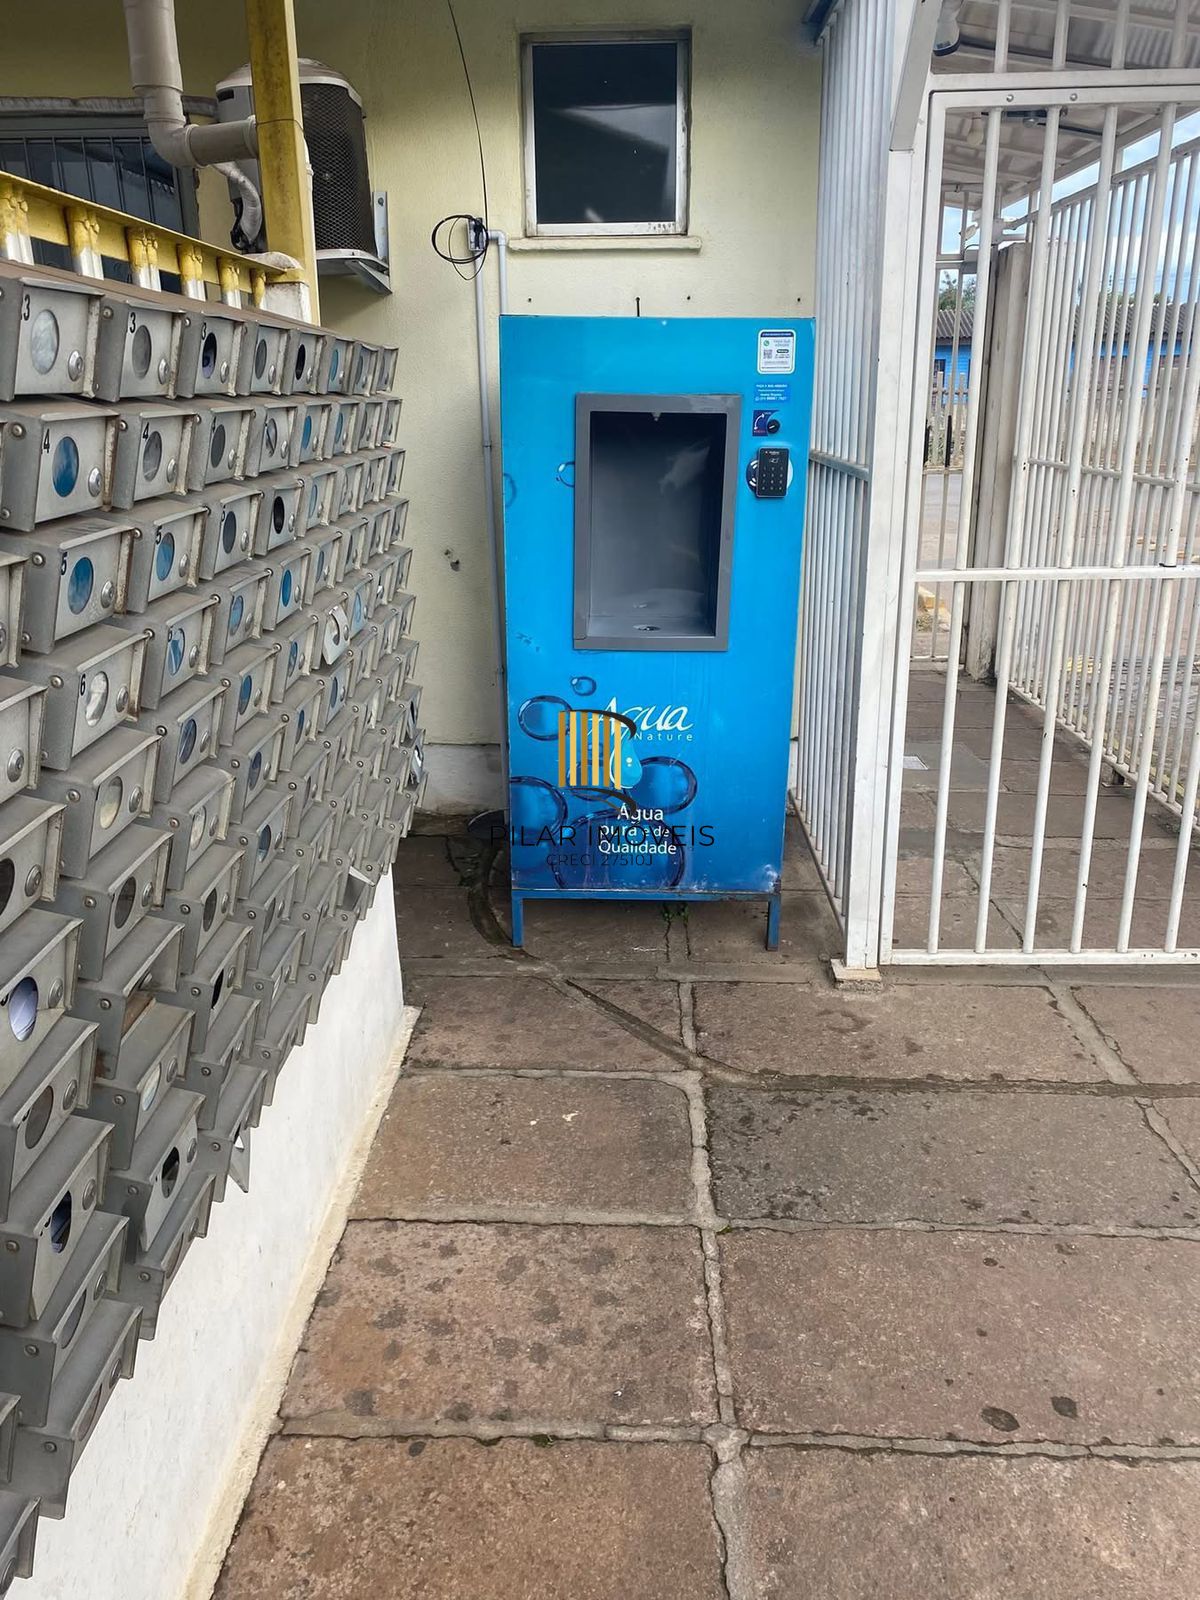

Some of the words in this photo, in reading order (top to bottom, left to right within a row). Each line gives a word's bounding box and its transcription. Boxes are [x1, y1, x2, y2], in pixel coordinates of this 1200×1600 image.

[23, 294, 31, 321] 3
[129, 311, 136, 334] 3
[43, 428, 50, 454] 4
[142, 421, 150, 440] 4
[60, 551, 68, 576] 5
[80, 673, 86, 696] 6
[633, 732, 693, 742] Nature
[653, 825, 670, 838] de
[598, 840, 677, 855] Qualidade
